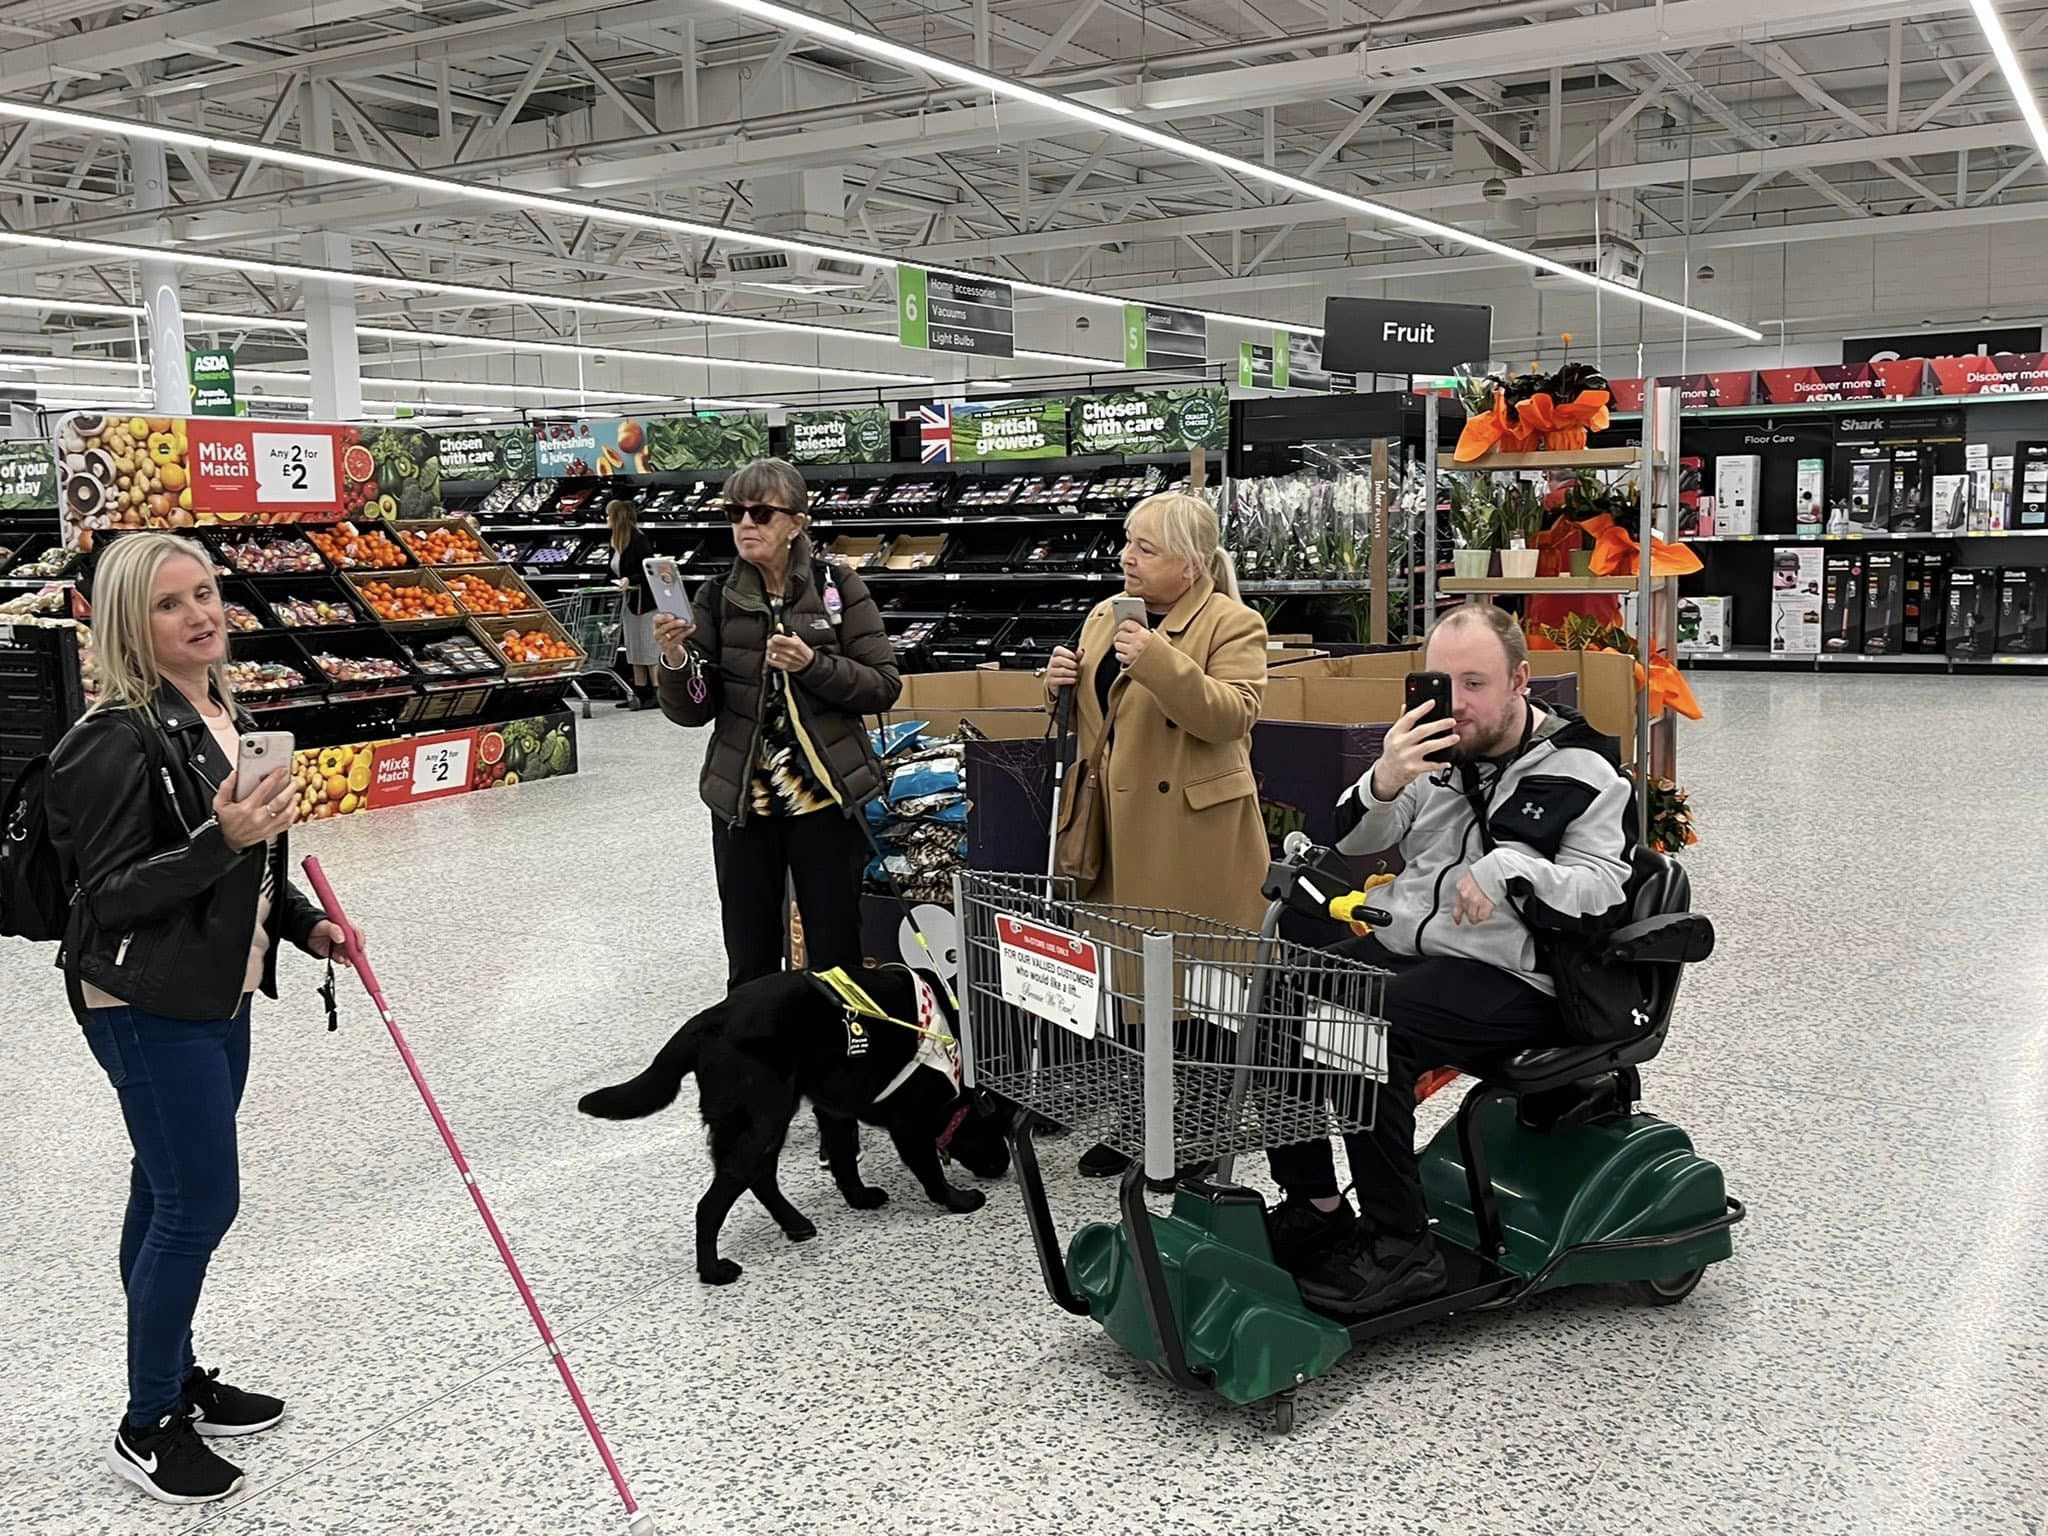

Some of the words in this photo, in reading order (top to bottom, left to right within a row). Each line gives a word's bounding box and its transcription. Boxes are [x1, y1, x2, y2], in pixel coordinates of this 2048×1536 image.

[930, 278, 953, 292] Home
[955, 284, 997, 299] accessories
[905, 294, 918, 321] 6
[932, 304, 967, 320] Vacuums
[932, 331, 952, 345] Light
[954, 334, 975, 347] Bulbs
[1129, 327, 1138, 350] 5
[1383, 322, 1435, 343] Fruit
[194, 355, 230, 372] ASDA
[1794, 381, 1840, 392] Discover
[1843, 380, 1872, 389] more
[1874, 378, 1886, 387] at
[1967, 371, 2018, 383] Discover
[1681, 389, 1707, 398] more
[1710, 388, 1720, 397] at
[1083, 401, 1147, 420] Chosen
[794, 420, 846, 437] Expertly
[981, 416, 1037, 436] British
[1082, 418, 1122, 437] with
[1125, 417, 1165, 432] care
[1841, 418, 1885, 431] Shark
[439, 438, 483, 452] Chosen
[539, 437, 595, 450] Refreshing
[795, 434, 847, 450] selected
[976, 433, 1045, 455] growers
[1744, 435, 1770, 444] Floor
[1772, 434, 1795, 443] Care
[199, 441, 247, 462] Mix&
[270, 448, 289, 459] Any
[291, 445, 302, 462] 2
[304, 449, 318, 459] for
[440, 452, 467, 466] with
[468, 451, 495, 463] care
[540, 454, 548, 464] &
[549, 452, 575, 465] juicy
[1, 461, 16, 478] of
[18, 462, 49, 480] your
[200, 462, 249, 477] Match
[283, 464, 308, 489] £2
[4, 483, 14, 494] a
[16, 479, 41, 497] day
[378, 755, 410, 773] Mix&
[439, 749, 448, 762] 2
[376, 770, 409, 784] Match
[432, 762, 449, 782] £2
[1045, 942, 1056, 952] USE
[1004, 947, 1016, 959] FOR
[1017, 952, 1031, 965] OUR
[1032, 957, 1055, 974] VALUED
[1056, 966, 1095, 989] CUSTOMERS
[1016, 965, 1029, 978] who
[1030, 972, 1049, 986] would
[1050, 976, 1061, 990] like
[1062, 984, 1067, 992] a
